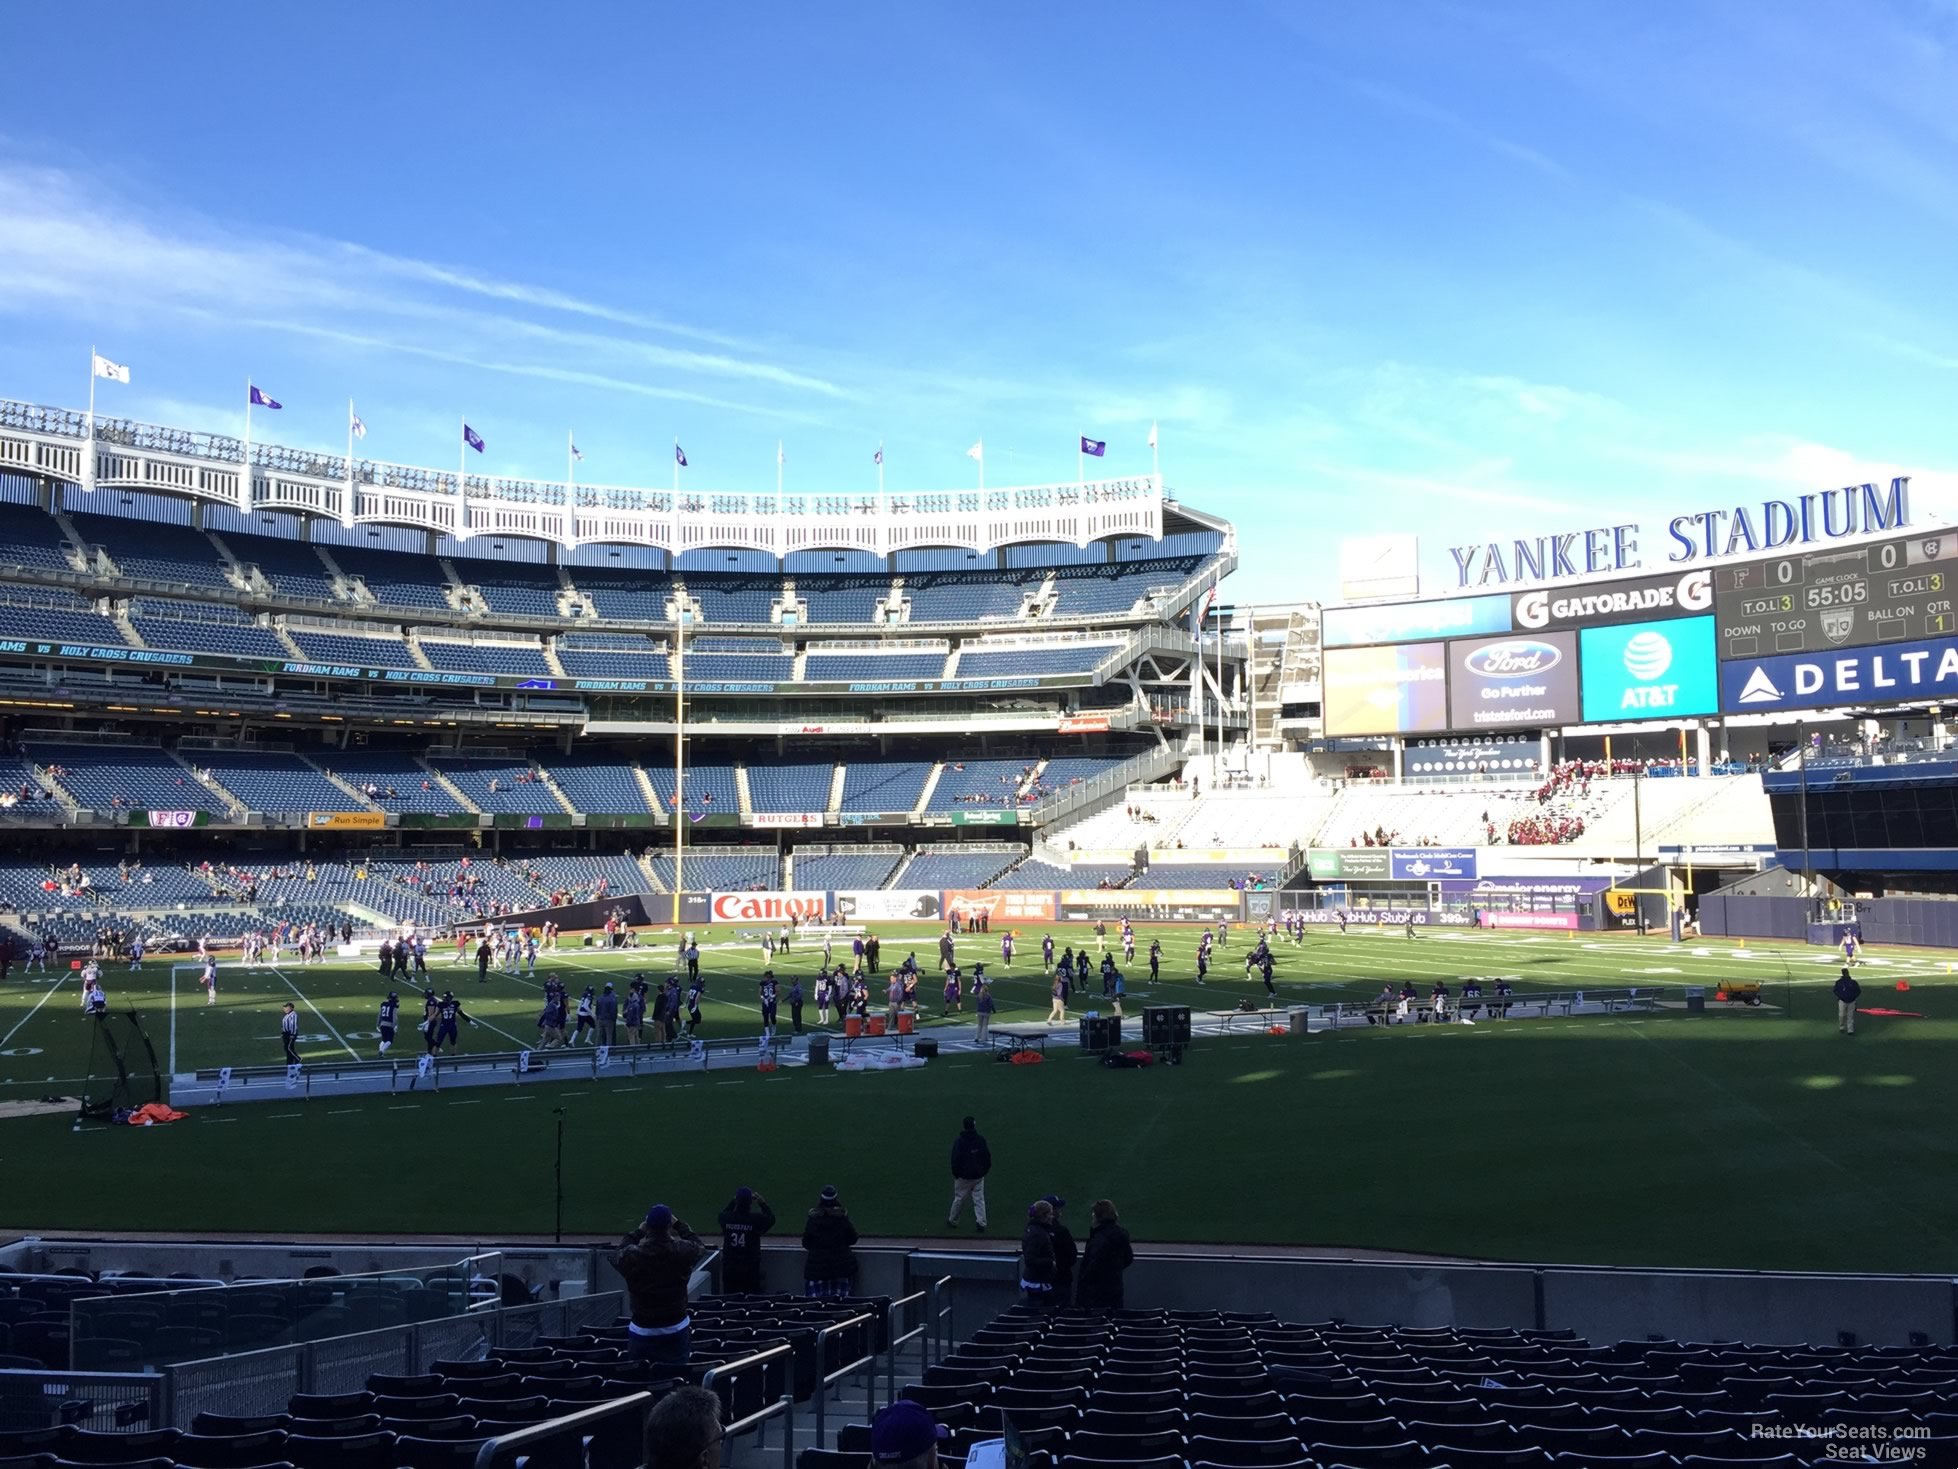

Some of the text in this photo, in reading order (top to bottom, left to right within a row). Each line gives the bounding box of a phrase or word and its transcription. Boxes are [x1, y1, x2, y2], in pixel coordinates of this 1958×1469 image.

[1448, 476, 1912, 588] YANKEE STADIUM
[1881, 545, 1897, 568] 0
[1778, 561, 1792, 583] 0
[1815, 573, 1859, 585] GAME CLOCK
[1930, 575, 1941, 590] 3
[1808, 582, 1866, 607] 55:05
[1551, 586, 1674, 619] GATORADE
[1781, 596, 1792, 611] 3
[1927, 601, 1950, 613] QTR
[1868, 606, 1914, 621] BALL ON
[1724, 625, 1761, 637] DOWN
[1770, 620, 1806, 632] TO GO
[1935, 616, 1944, 631] 1
[0, 640, 26, 652] AMS
[60, 645, 88, 656] HOLY
[90, 648, 127, 660] CROSS
[129, 652, 193, 664] CRUSADERS
[1483, 648, 1542, 673] Ford
[283, 663, 331, 675] FORDHAM
[332, 667, 360, 677] RAMS
[385, 671, 409, 681] HOLY
[410, 673, 441, 682] CROSS
[442, 675, 495, 685] CRUSADERS
[1795, 648, 1958, 695] DELTA
[575, 680, 619, 690] FORDHAM
[620, 682, 646, 690] RAMS
[671, 683, 693, 691] HLY
[694, 683, 722, 691] CROSS
[723, 683, 774, 692] CRUSADERS
[849, 683, 890, 692] FORDHAM
[891, 682, 916, 691] RAMS
[940, 681, 960, 690] HOLY
[962, 681, 989, 690] CROSS
[990, 678, 1040, 689] CRUSADERS
[1481, 685, 1546, 699] Go Further
[1621, 684, 1678, 709] AT&T
[315, 815, 380, 826] SAP Run Simple
[759, 814, 817, 823] RUTGERS
[714, 895, 825, 920] Canon
[1282, 911, 1328, 922] SubHub
[1331, 911, 1377, 922] SubHub
[381, 1006, 390, 1017] 21
[731, 1232, 746, 1248] 34
